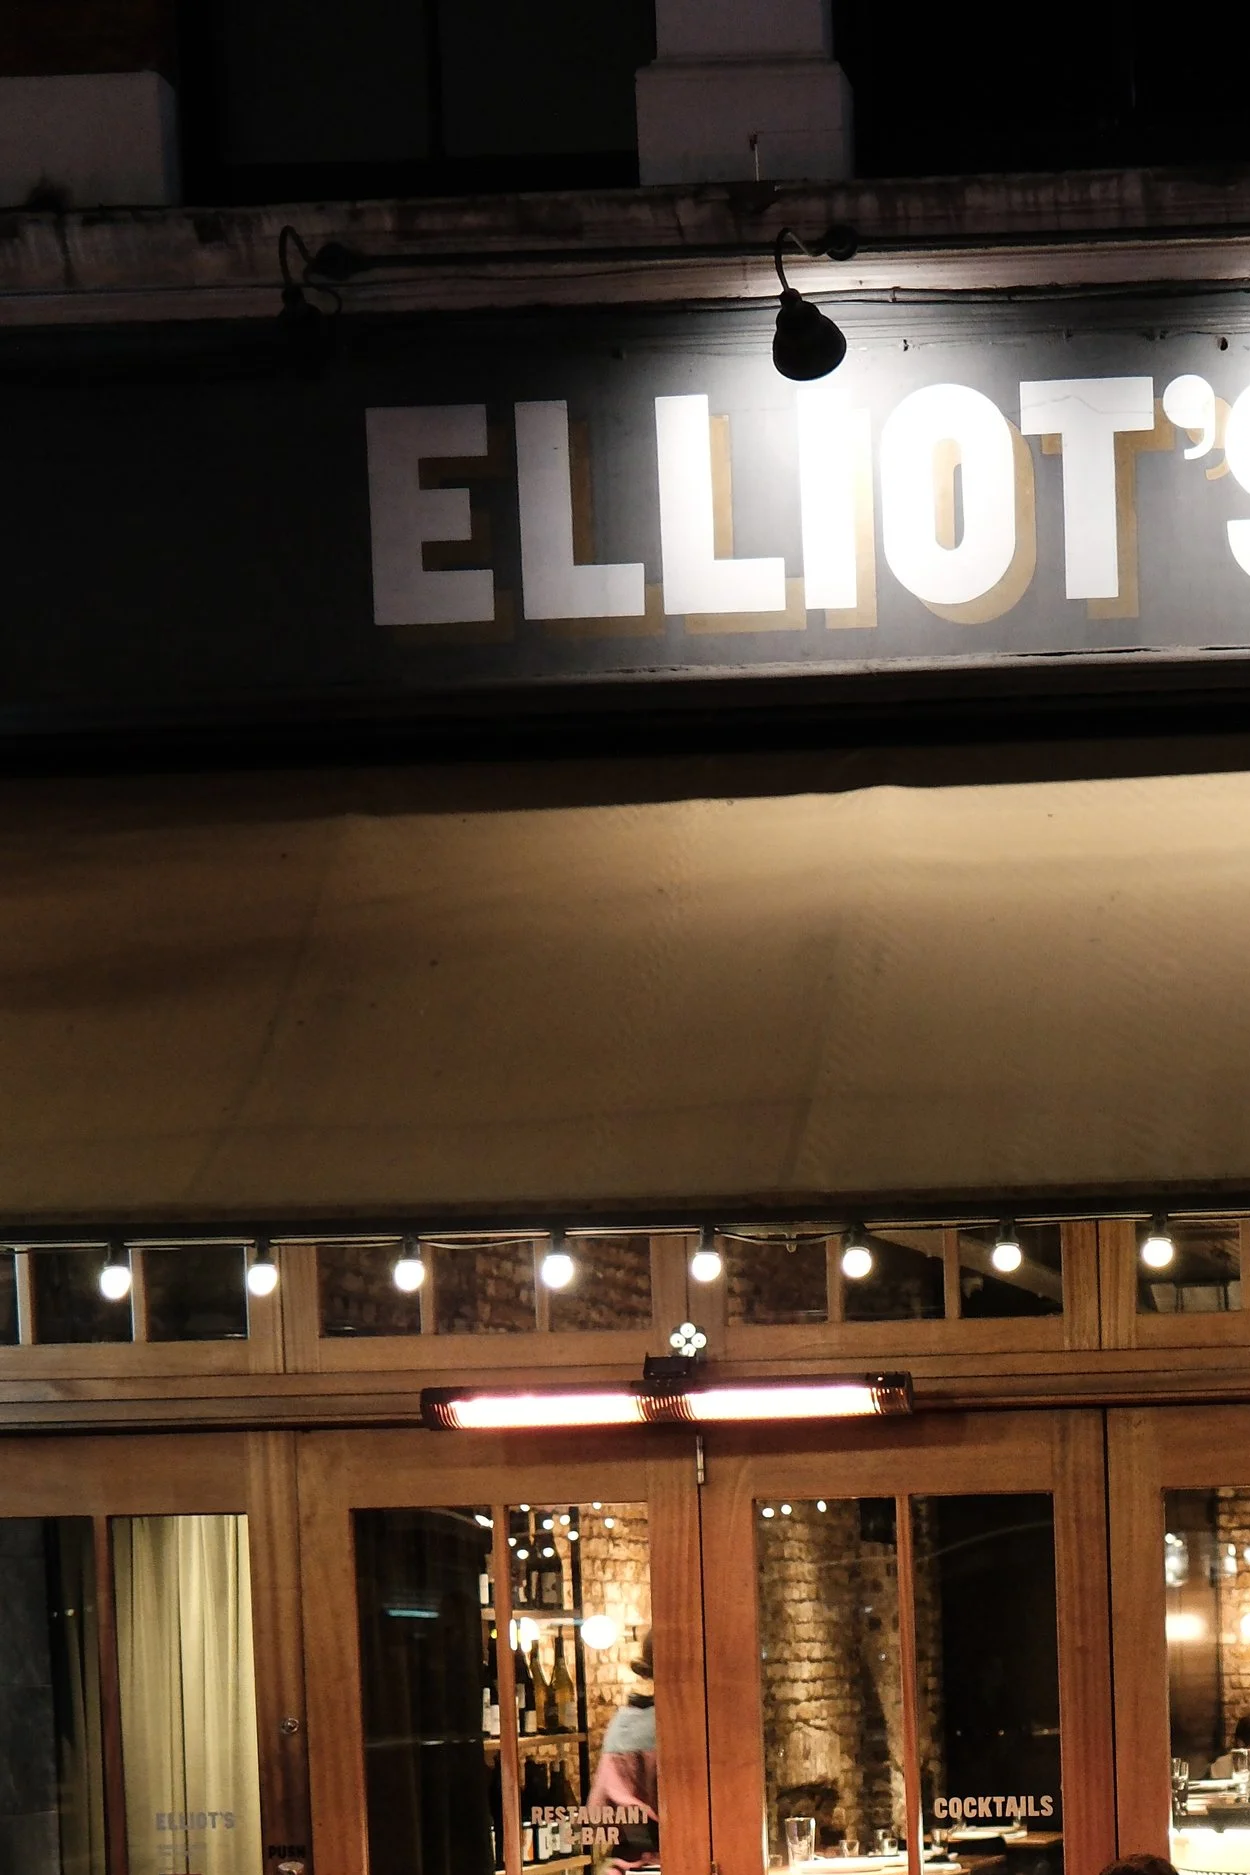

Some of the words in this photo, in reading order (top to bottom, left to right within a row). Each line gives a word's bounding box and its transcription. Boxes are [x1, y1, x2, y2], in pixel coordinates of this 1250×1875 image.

[530, 1804, 650, 1826] RESTAURANT
[933, 1794, 1055, 1819] COCKTAILS
[581, 1826, 620, 1846] BAR
[267, 1844, 308, 1860] PUSH
